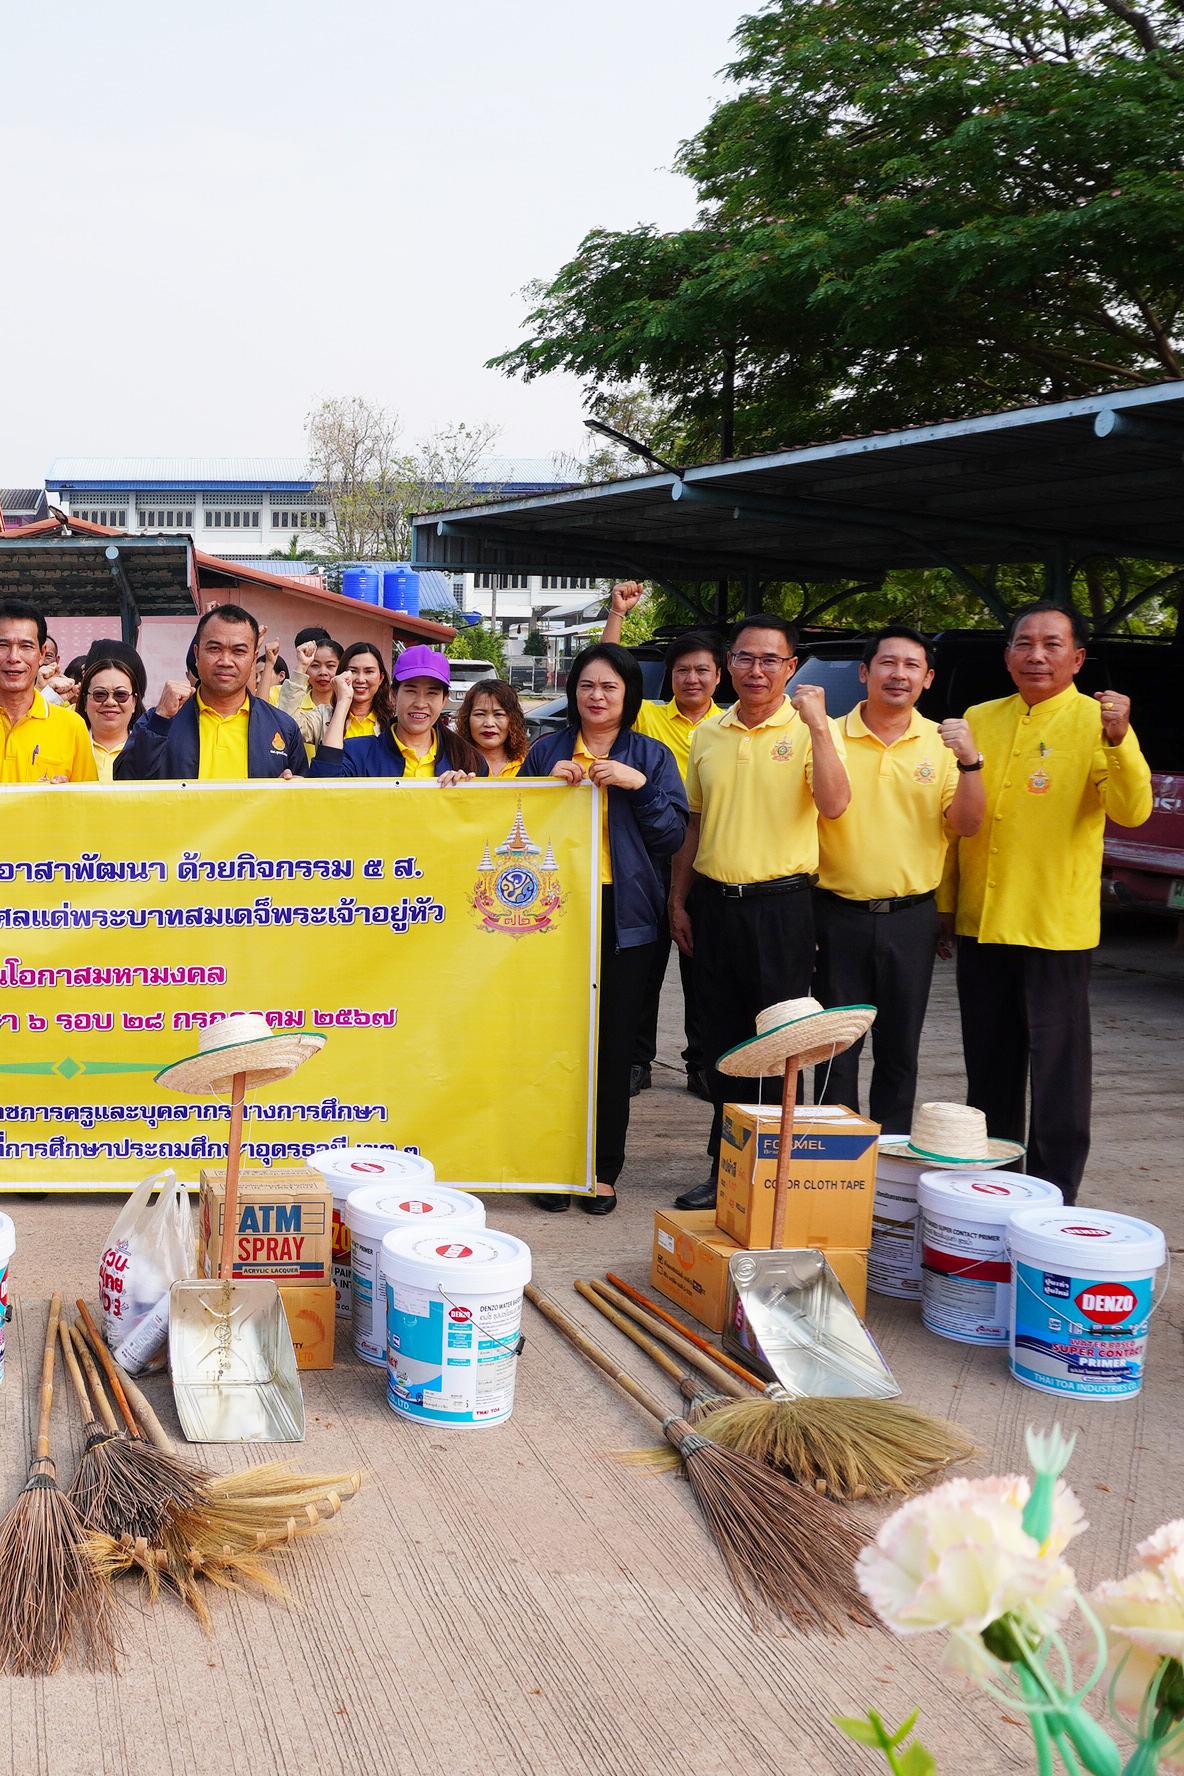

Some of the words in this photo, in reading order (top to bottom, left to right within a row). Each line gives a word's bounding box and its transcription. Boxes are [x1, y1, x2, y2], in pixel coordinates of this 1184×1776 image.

[178, 852, 353, 880] ด้วยกิจกรรม
[363, 859, 383, 877] ๕
[394, 857, 422, 877] ส.
[28, 1014, 47, 1031] ๖
[55, 1013, 112, 1030] รอบ
[123, 1012, 163, 1029] ๒๘
[313, 1009, 396, 1027] ๒๕๖๗
[764, 1139, 826, 1150] FOMEL
[764, 1179, 800, 1189] COOR
[804, 1181, 837, 1190] CLOTH
[840, 1181, 865, 1189] TAPE
[238, 1205, 301, 1233] ATM
[238, 1237, 304, 1261] SPRAY
[1082, 1293, 1134, 1312] DENZO
[1052, 1344, 1094, 1357] SUPER
[1079, 1358, 1127, 1367] PRIMER
[1034, 1374, 1055, 1386] THAI
[1056, 1379, 1075, 1390] TOA
[398, 1398, 411, 1411] LTD.
